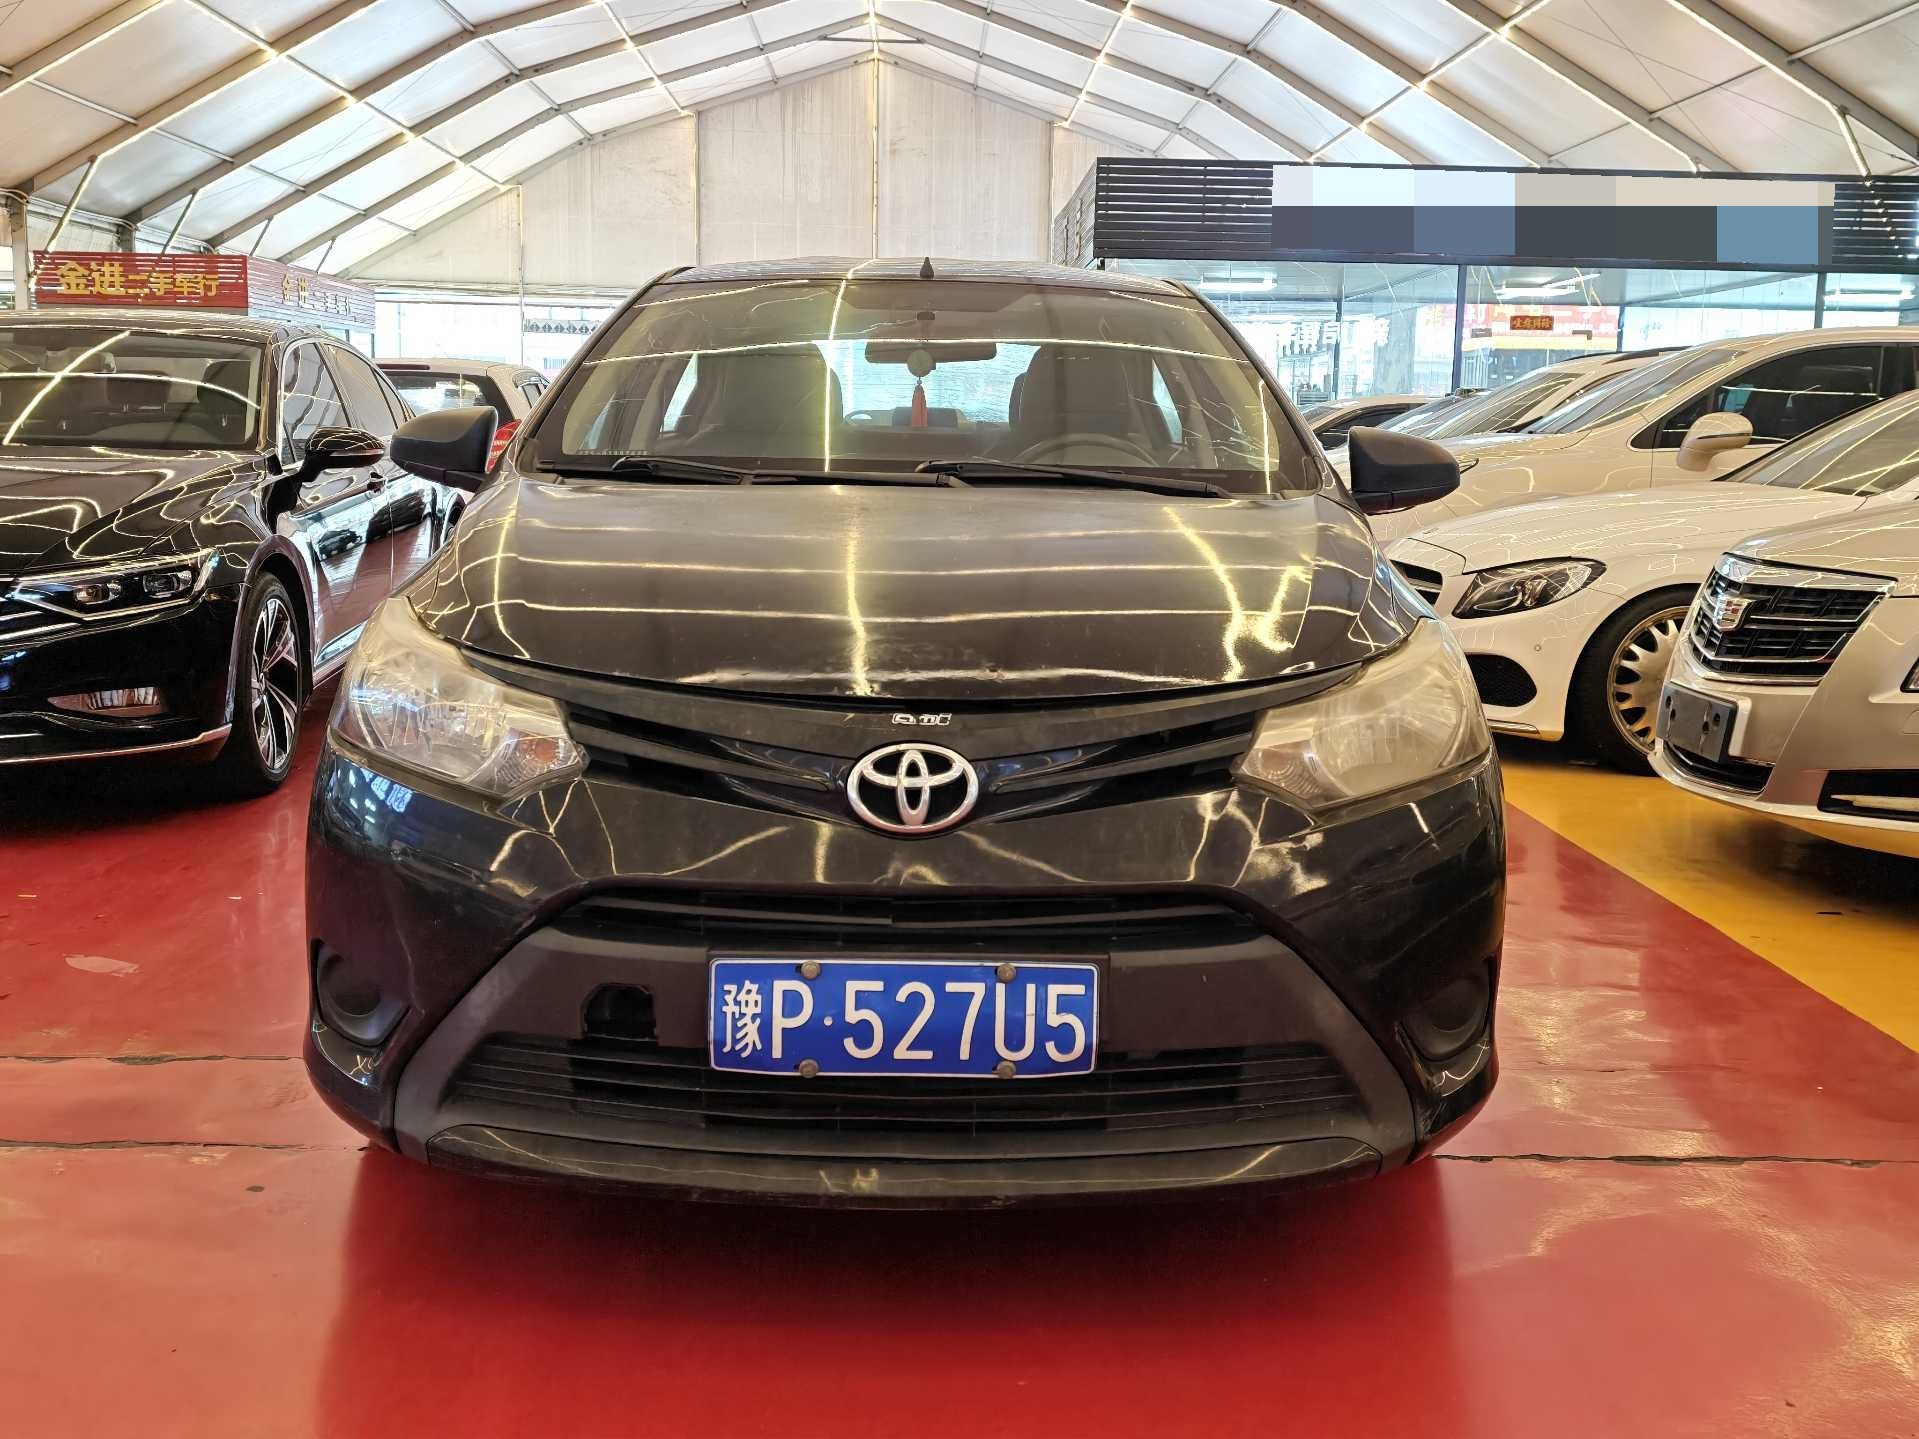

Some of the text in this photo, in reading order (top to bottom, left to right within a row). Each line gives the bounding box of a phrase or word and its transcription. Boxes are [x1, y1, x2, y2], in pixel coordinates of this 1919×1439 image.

[56, 261, 219, 296] 金进二手车行
[722, 979, 1086, 1063] 豫P·527U5
